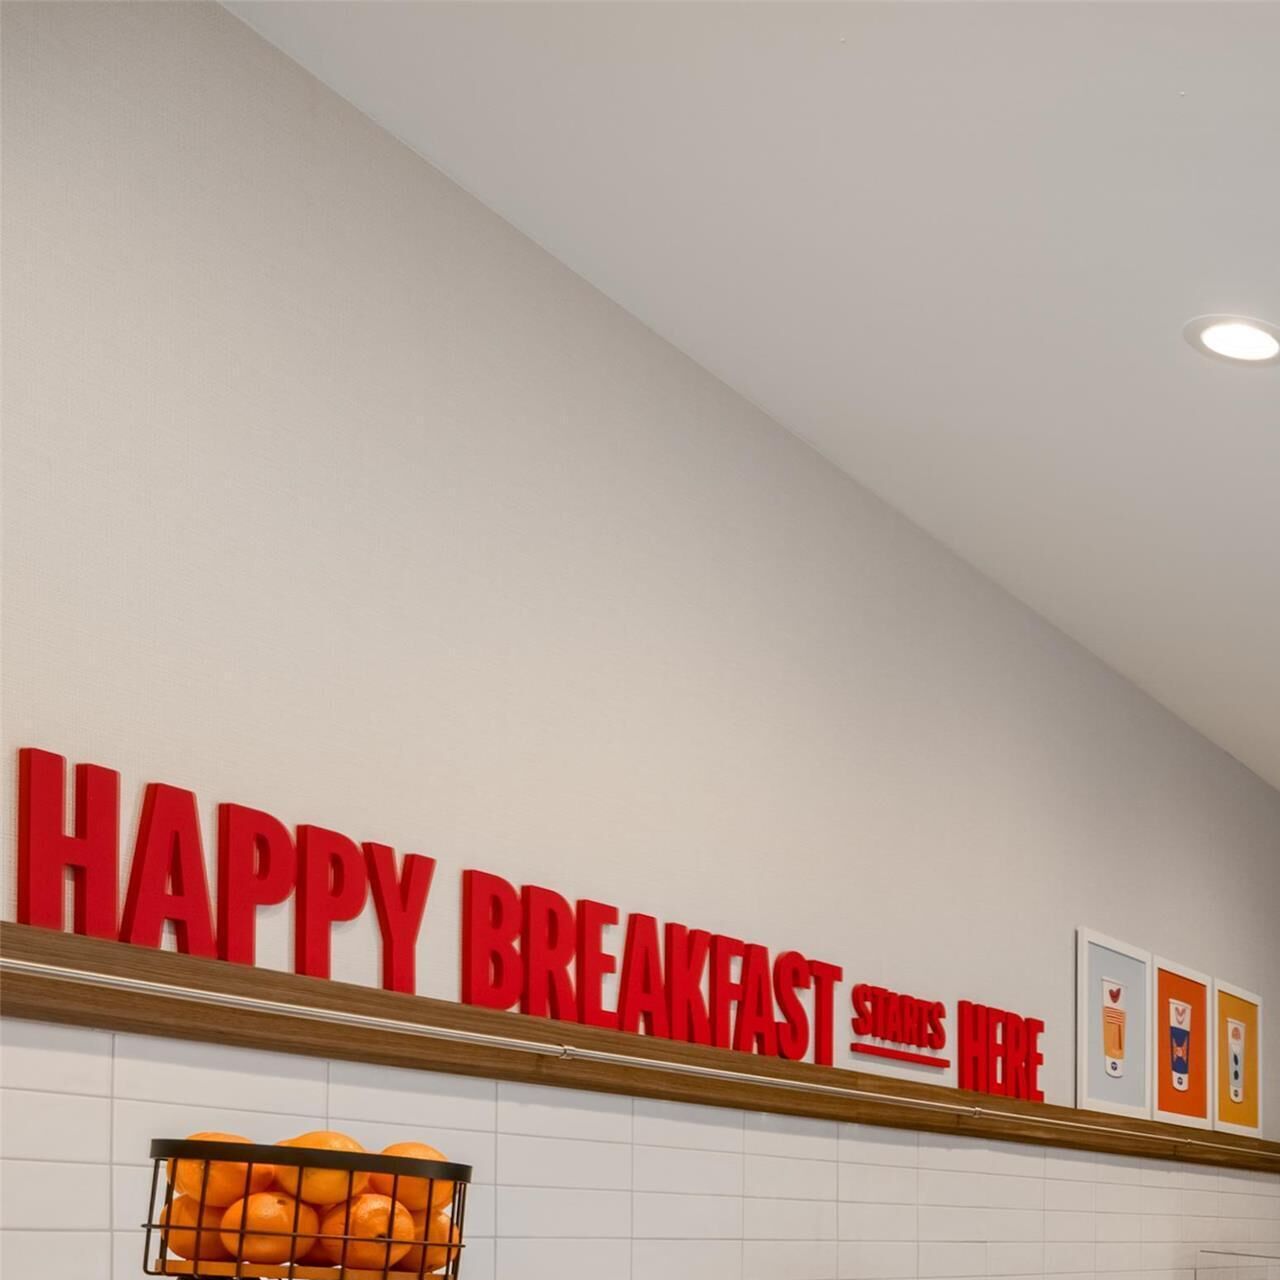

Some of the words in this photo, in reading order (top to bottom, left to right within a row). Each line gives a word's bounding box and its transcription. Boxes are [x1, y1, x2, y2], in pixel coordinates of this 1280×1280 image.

[17, 747, 436, 995] HAPPY
[462, 869, 843, 1066] BREAKFAST
[851, 984, 946, 1050] STARTS
[957, 1000, 1045, 1104] HERE
